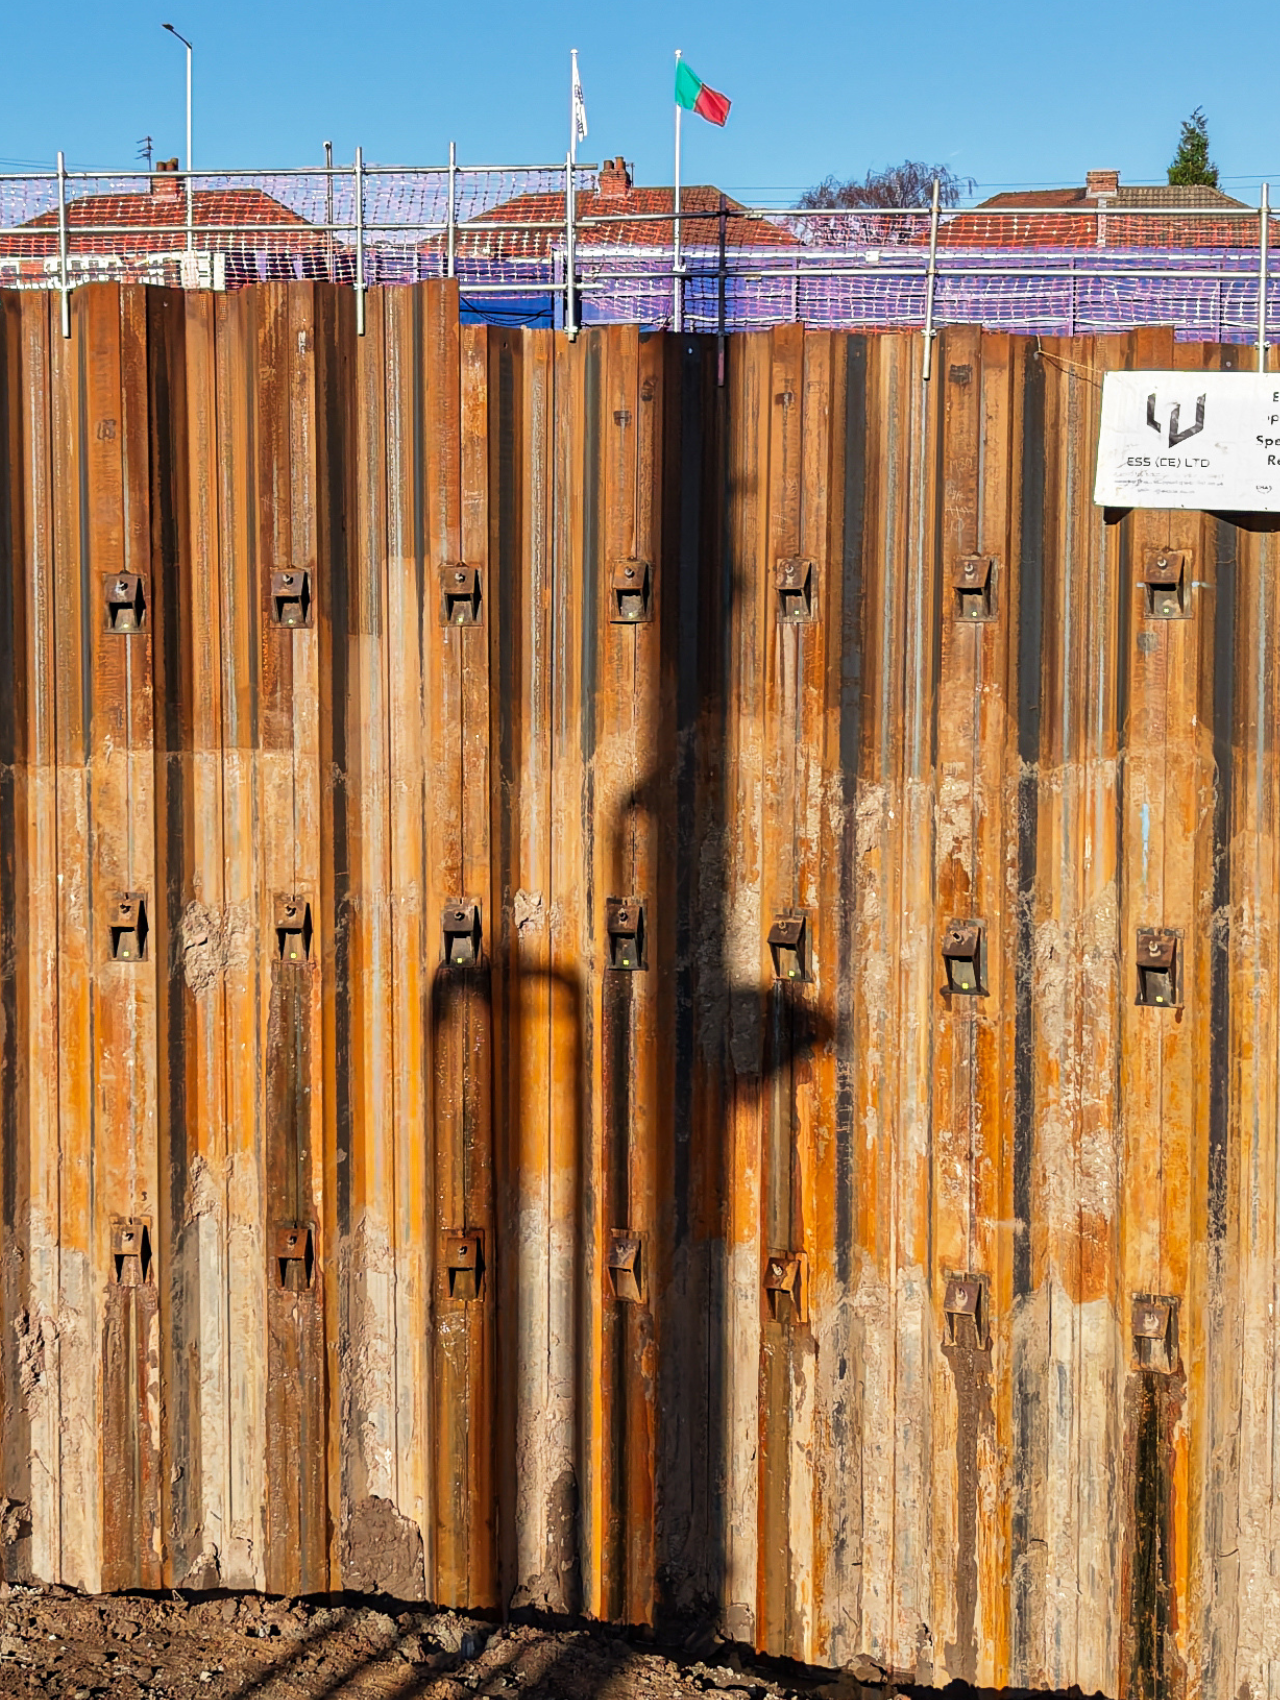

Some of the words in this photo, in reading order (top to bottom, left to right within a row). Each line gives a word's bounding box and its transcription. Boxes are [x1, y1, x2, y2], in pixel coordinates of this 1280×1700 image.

[1126, 456, 1151, 467] ESS
[1155, 456, 1181, 468] (CE)
[1185, 457, 1210, 468] LTD
